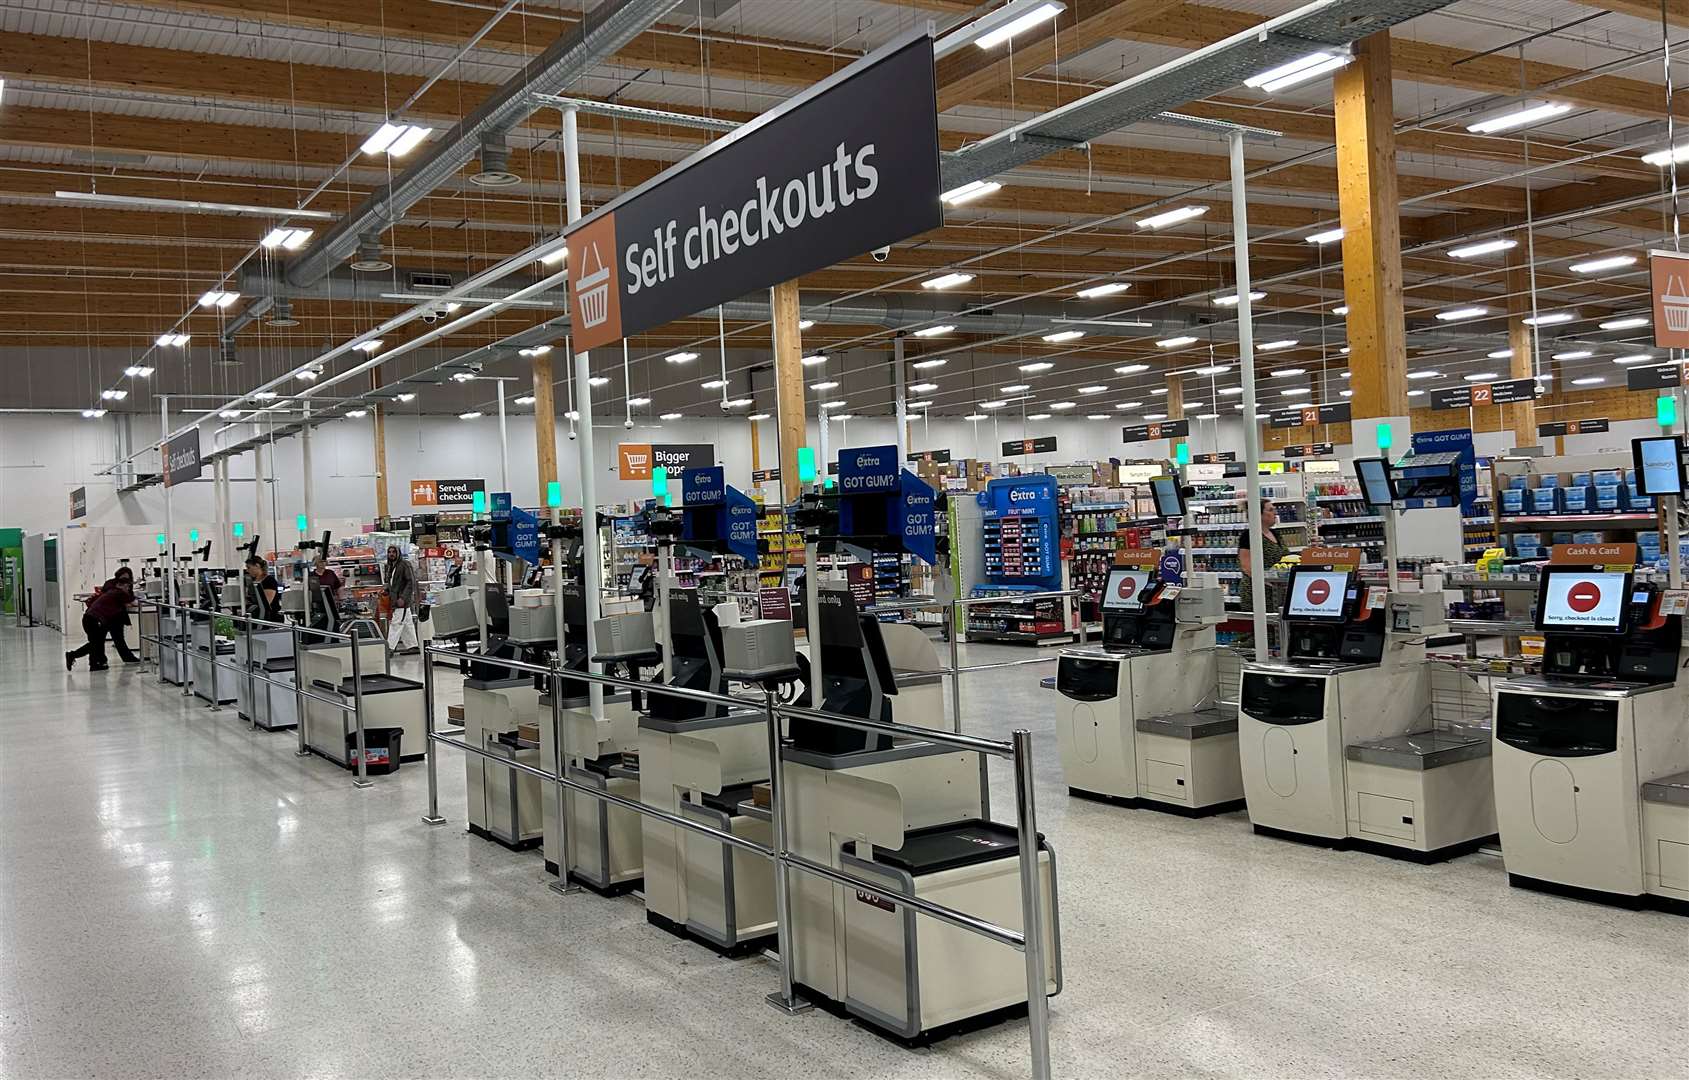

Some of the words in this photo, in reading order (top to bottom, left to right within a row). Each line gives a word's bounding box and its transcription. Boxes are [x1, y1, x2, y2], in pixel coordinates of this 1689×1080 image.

[625, 220, 677, 295] Self
[684, 142, 879, 270] checkouts
[1474, 390, 1489, 401] 22
[1305, 411, 1316, 421] 21
[1150, 427, 1160, 436] 20
[1434, 434, 1449, 442] GOT
[1450, 433, 1471, 441] GUM?
[655, 451, 690, 464] Bigger
[857, 457, 880, 467] extra
[655, 464, 686, 476] ops
[695, 473, 711, 484] extra
[844, 477, 864, 488] GOT
[866, 475, 894, 487] GUM?
[439, 484, 467, 492] Served
[439, 493, 473, 501] checkou
[686, 491, 701, 502] GOT
[701, 490, 721, 500] GUM?
[907, 495, 930, 505] extra
[1010, 490, 1036, 502] extra
[731, 506, 752, 514] extra
[907, 514, 928, 524] GOT
[731, 522, 750, 531] GOT
[905, 525, 933, 535] GUM?
[730, 531, 755, 540] GUM?
[1567, 548, 1589, 556] Cash
[1590, 547, 1598, 555] &
[1599, 547, 1620, 555] Card
[827, 595, 841, 606] only
